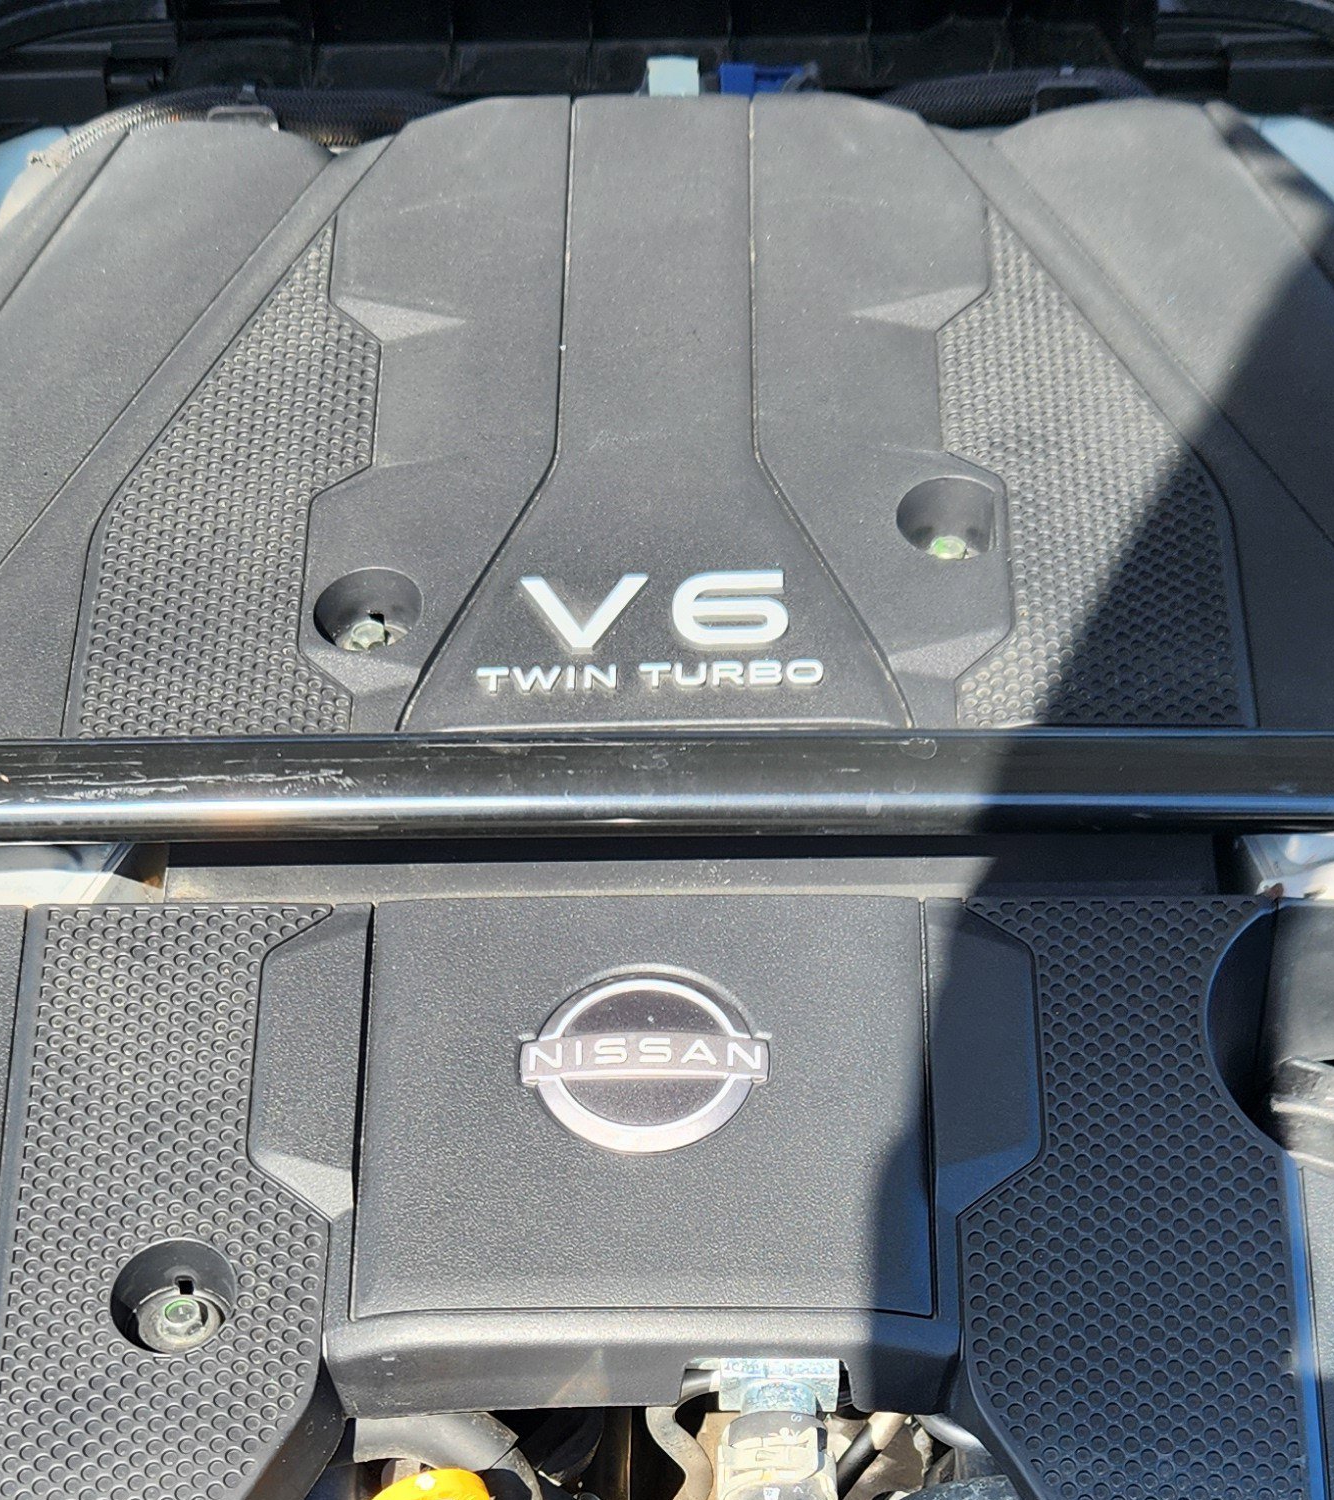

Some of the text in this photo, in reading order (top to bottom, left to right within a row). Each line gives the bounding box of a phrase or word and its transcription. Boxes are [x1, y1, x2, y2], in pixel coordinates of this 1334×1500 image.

[519, 568, 791, 655] V6
[476, 658, 825, 695] TWIN TURBO
[526, 1036, 764, 1073] NISSAN
